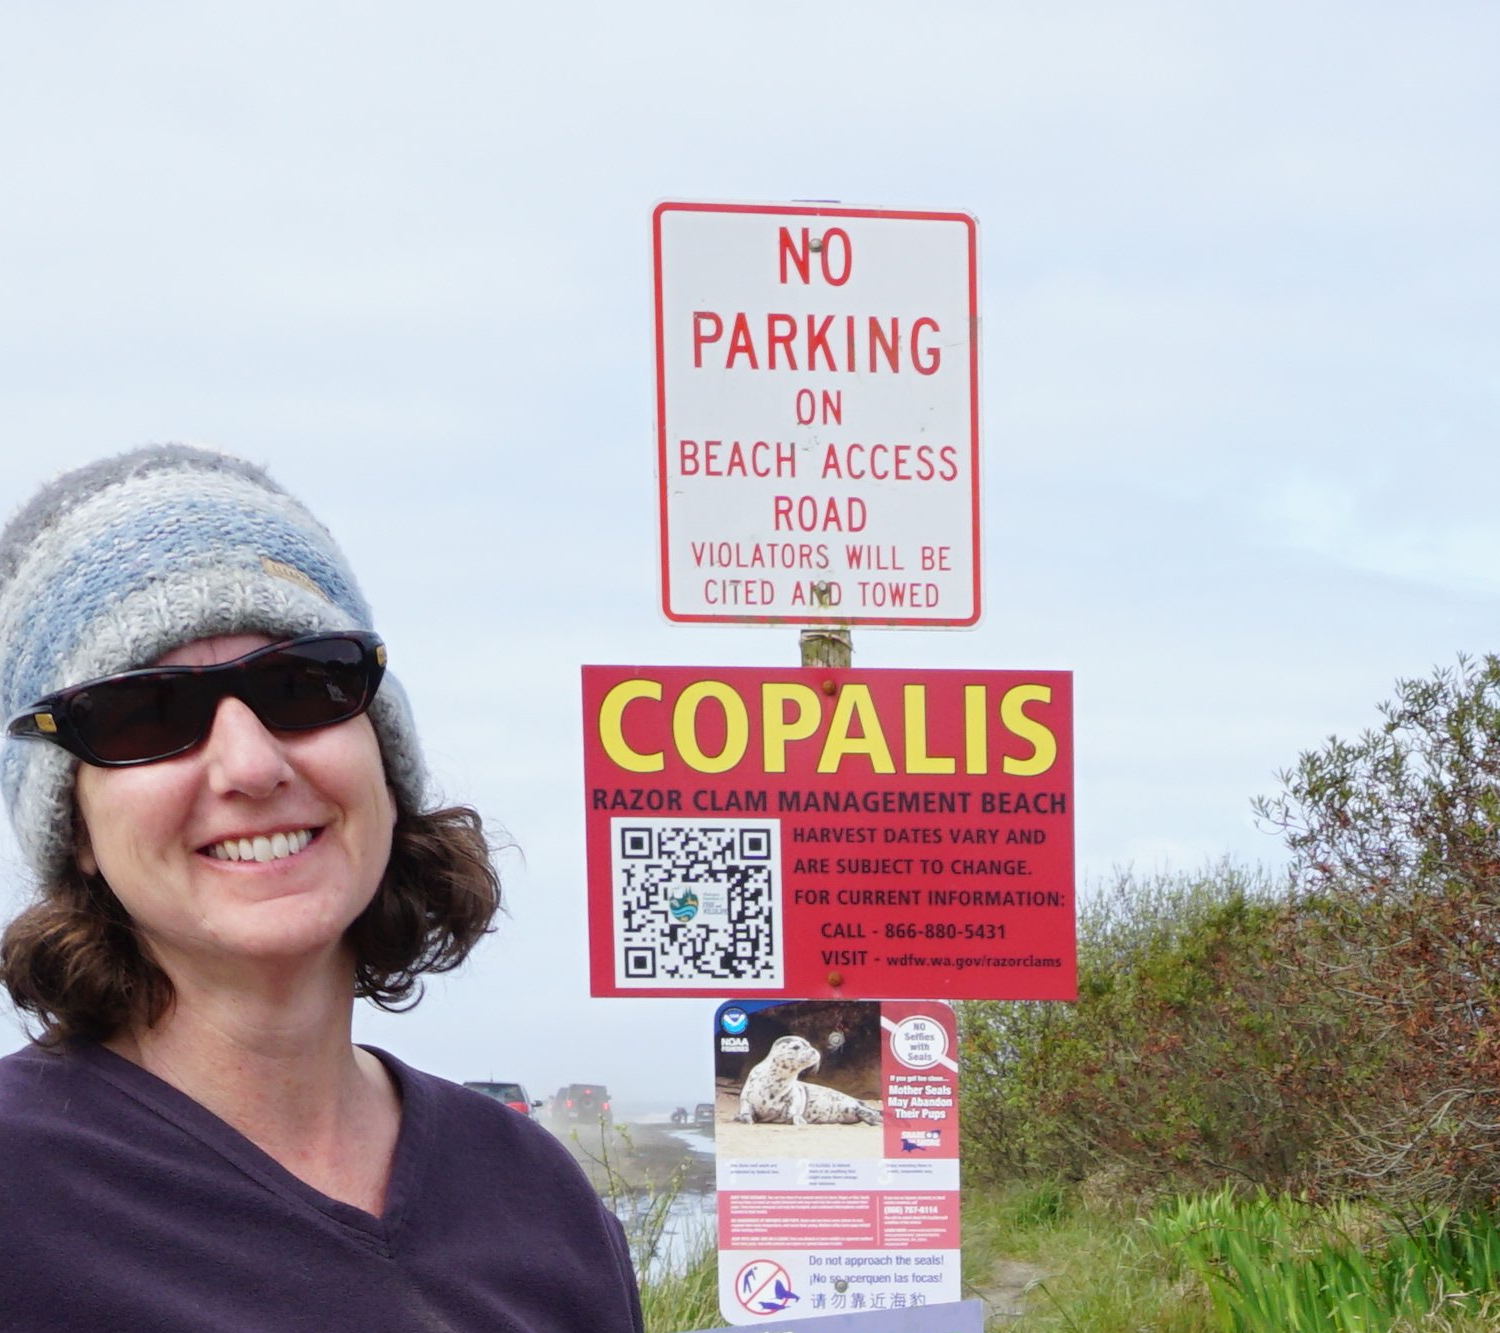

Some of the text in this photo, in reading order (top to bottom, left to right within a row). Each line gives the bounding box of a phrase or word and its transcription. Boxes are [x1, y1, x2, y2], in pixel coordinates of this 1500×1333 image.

[778, 227, 853, 286] NO
[693, 311, 942, 376] PARKING
[796, 388, 843, 426] ON
[680, 440, 958, 481] BEACH ACCESS
[774, 496, 867, 533] ROAD
[691, 542, 952, 572] VIOLATORS WILL BE
[704, 580, 940, 608] CITED AND TOWED
[598, 679, 1057, 777] COPALIS
[593, 789, 1066, 815] RAZOR CLAM MANAGEMENT BEACH
[793, 828, 1046, 845] HARVEST DATES VARY AND
[793, 859, 1032, 876] ARE SUBJECT TO CHANGE.
[794, 890, 1066, 907] FOR CURRENT INFORMATION:
[821, 923, 866, 938] CALL
[884, 923, 1006, 939] 866-880-5431
[821, 951, 868, 966] VISIT
[886, 954, 1062, 970] wdfw.wa.gov/razorclams
[913, 1023, 926, 1031] NO
[904, 1033, 935, 1041] Selfies
[910, 1043, 930, 1051] with
[907, 1053, 932, 1061] Seals
[888, 1085, 952, 1095] Mother Seals
[888, 1097, 953, 1108] May Abandon
[895, 1109, 946, 1120] Their Pups
[809, 1255, 944, 1268] Do not approach the seals!
[810, 1273, 827, 1285] ¡No
[845, 1274, 891, 1286] acerquen
[894, 1273, 909, 1284] las
[912, 1273, 943, 1284] focas!
[811, 1292, 926, 1309] 请勿靠近海豹
